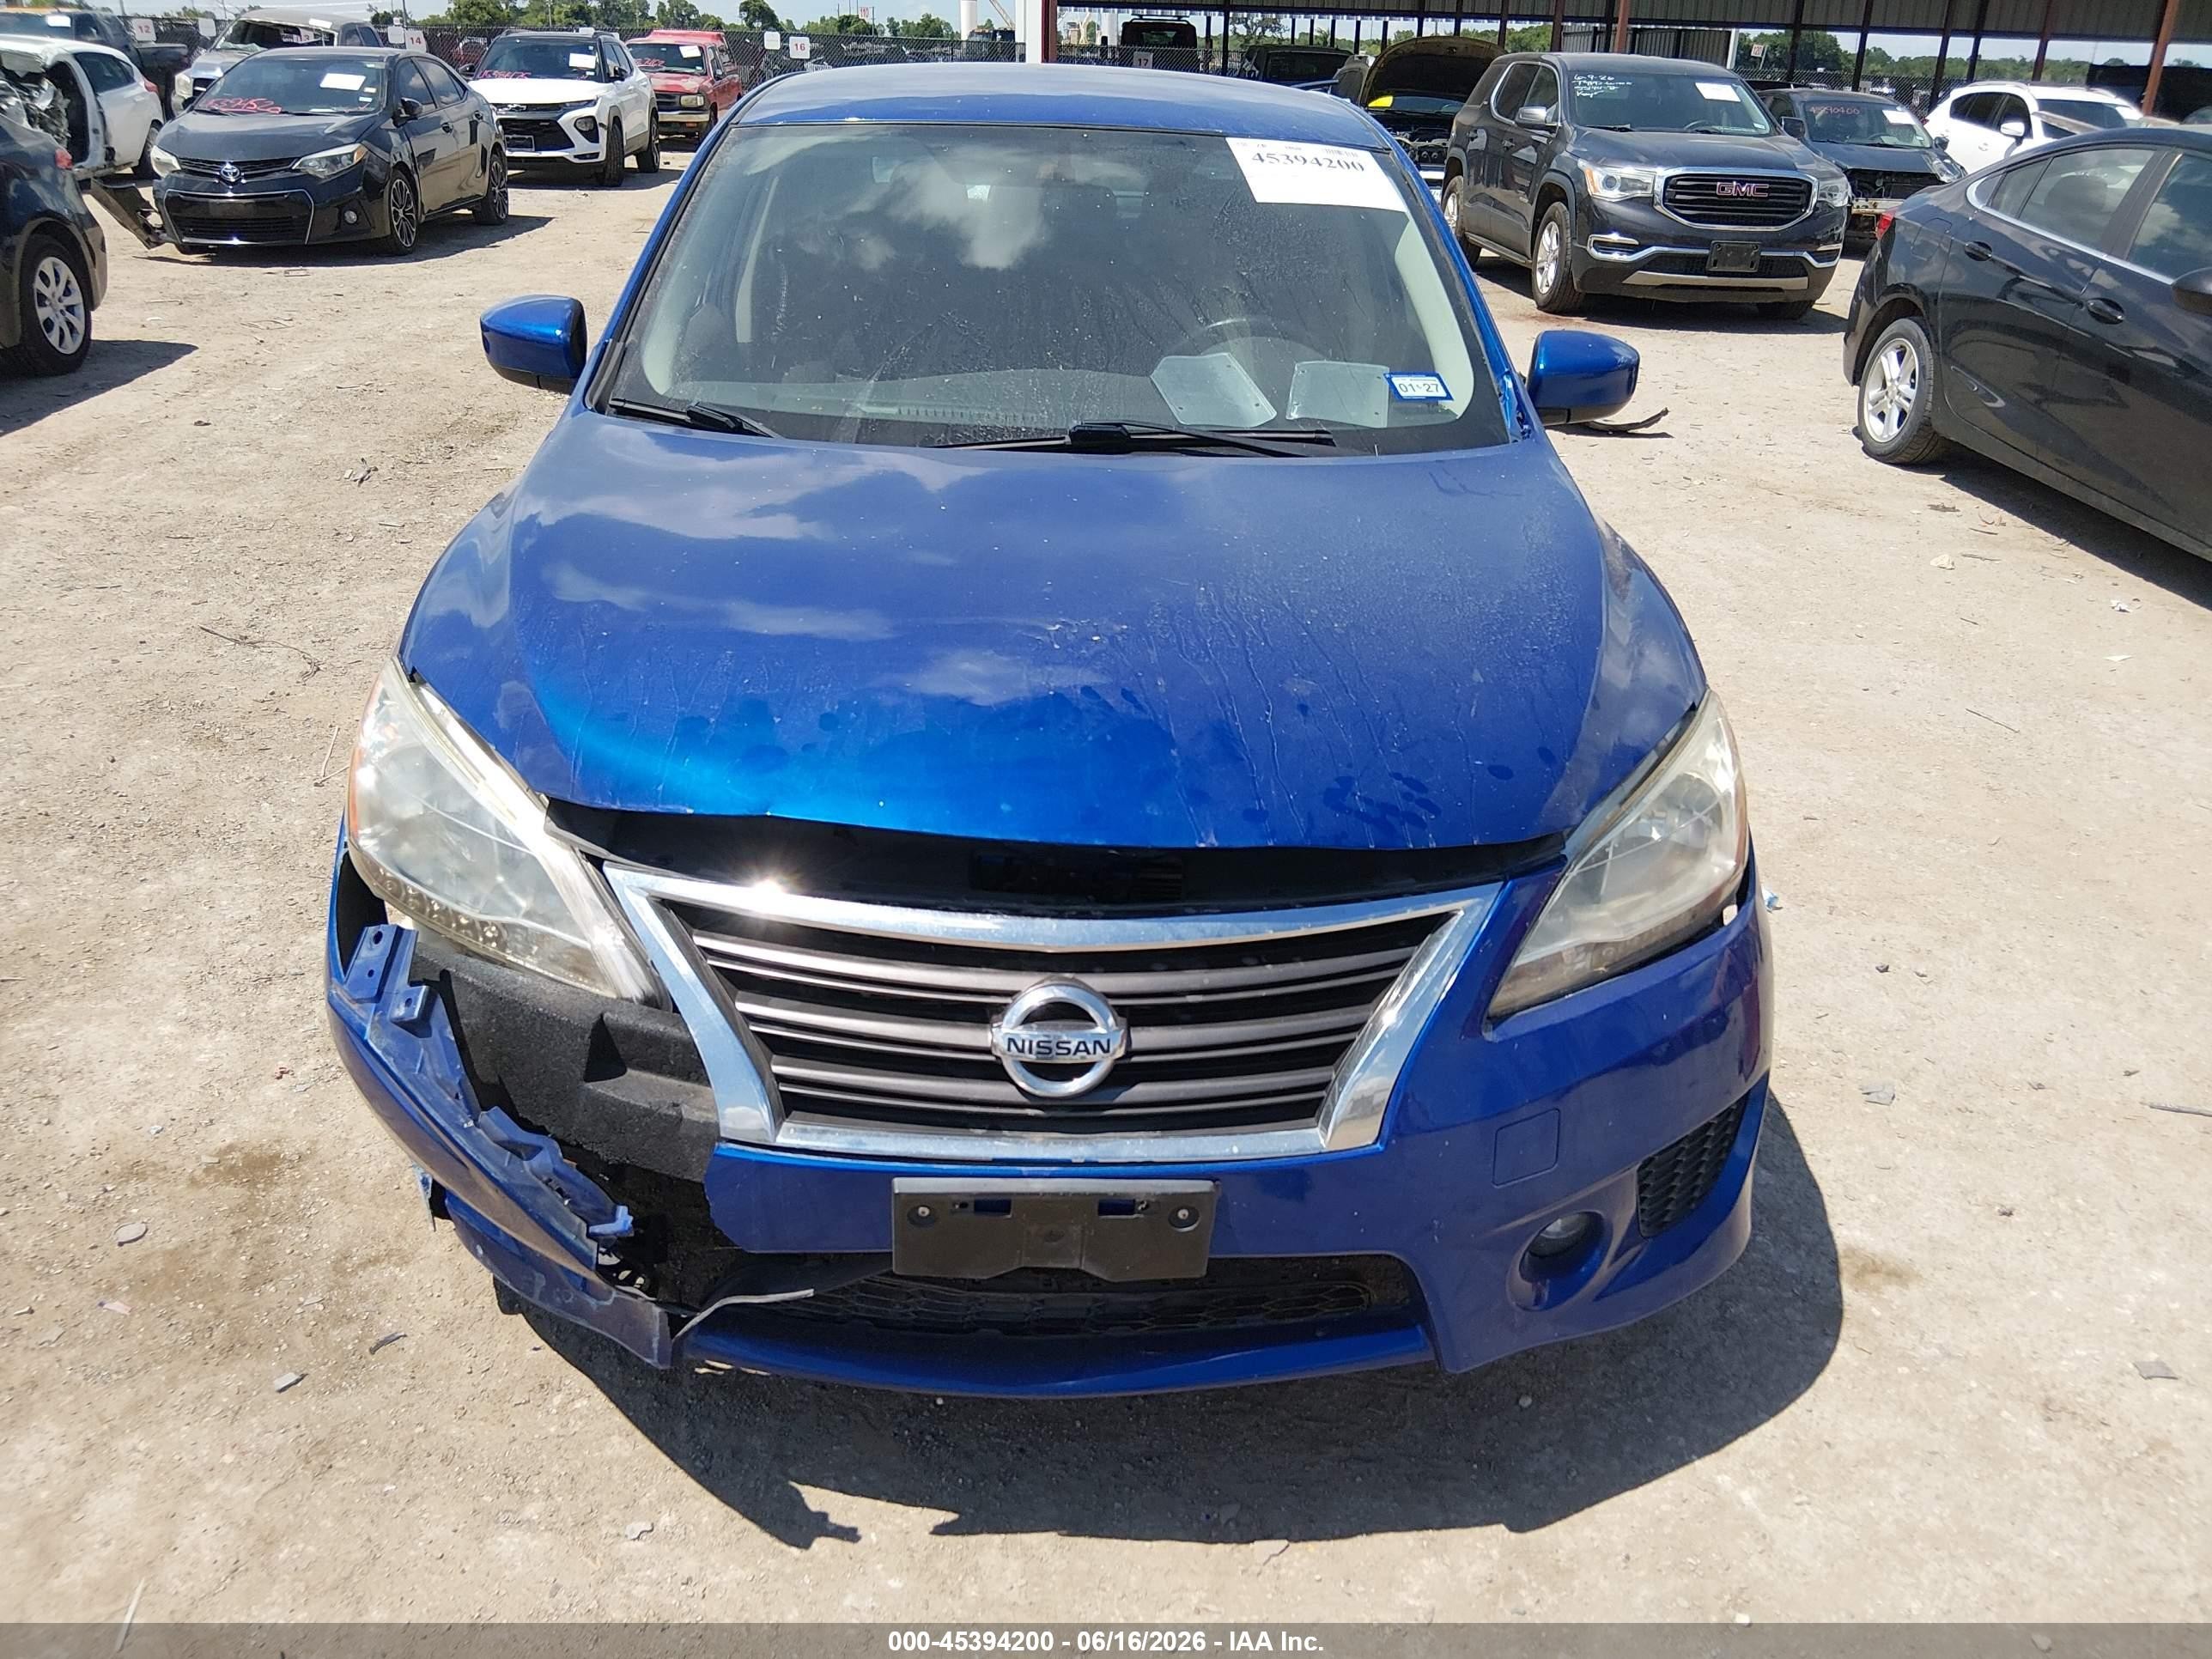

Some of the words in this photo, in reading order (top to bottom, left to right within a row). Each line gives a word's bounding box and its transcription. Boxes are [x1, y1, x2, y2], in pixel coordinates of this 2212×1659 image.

[137, 25, 152, 33] 12
[410, 36, 422, 45] 14
[794, 43, 805, 52] 16
[1138, 58, 1149, 67] 17
[1251, 152, 1365, 173] 45394200
[1717, 181, 1769, 198] GMC
[1007, 1037, 1111, 1056] NISSAN
